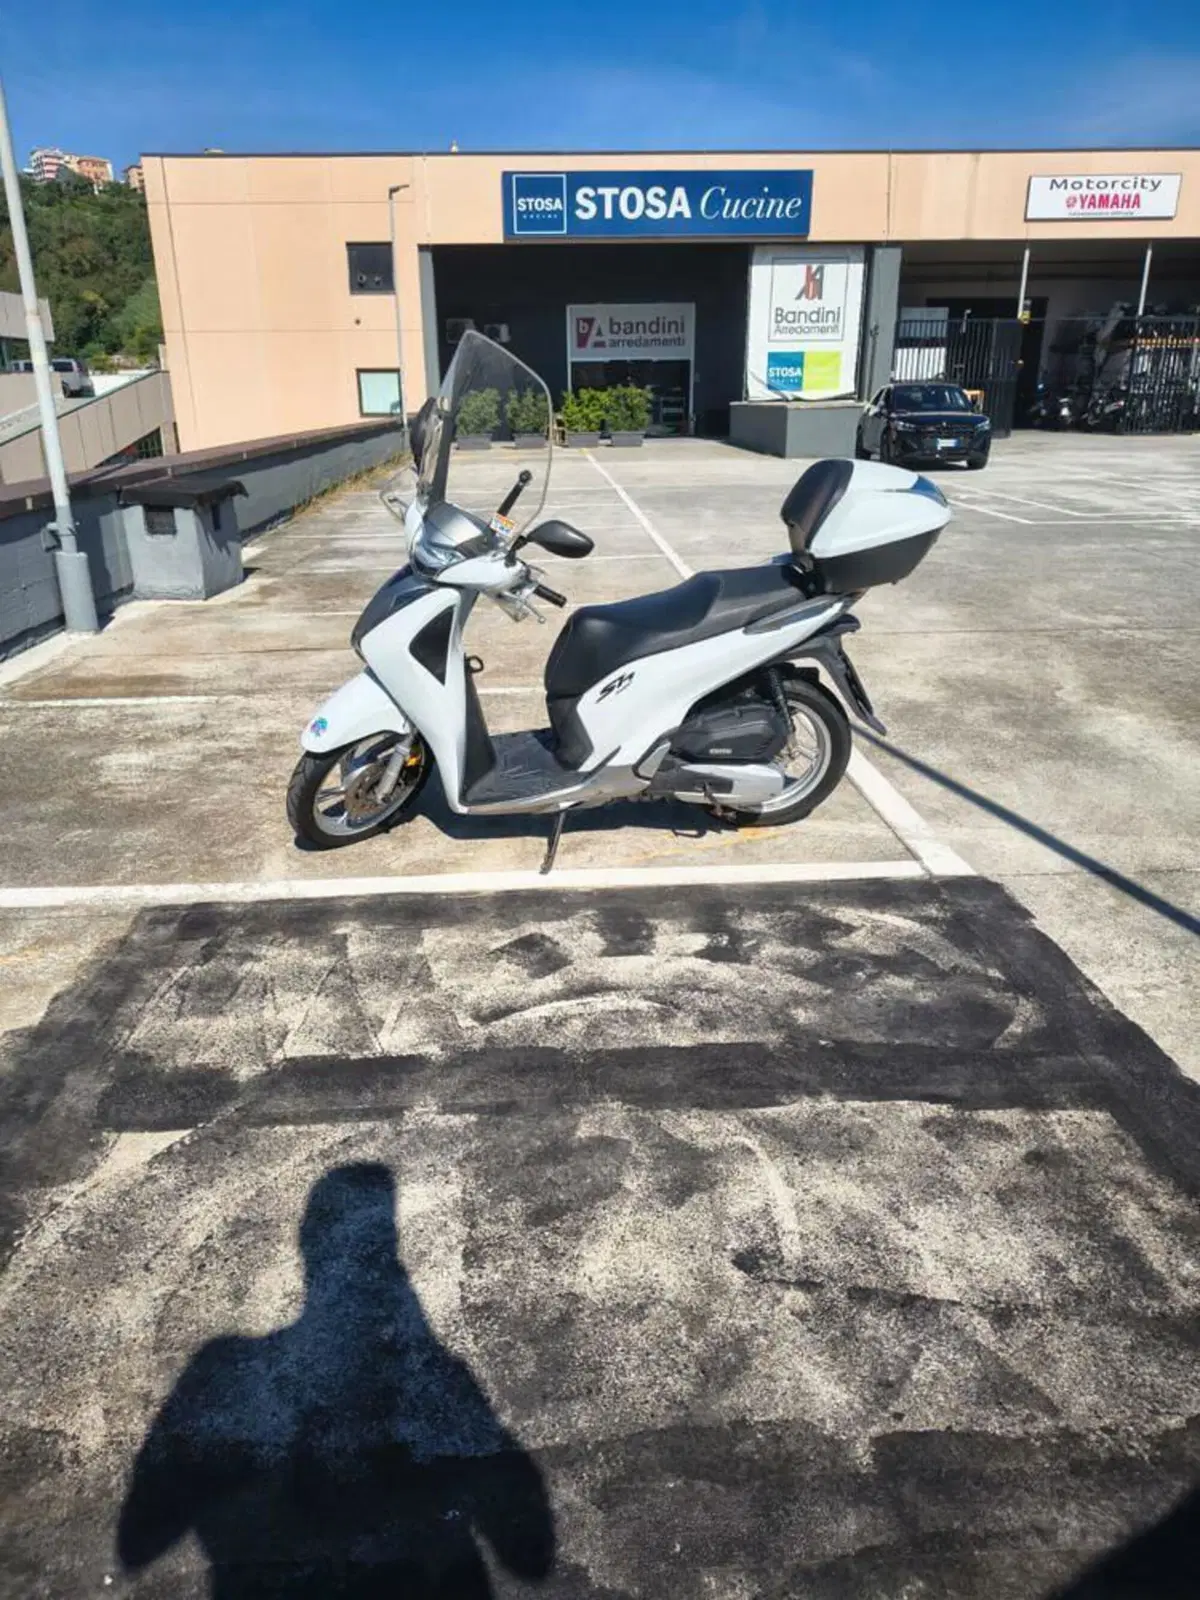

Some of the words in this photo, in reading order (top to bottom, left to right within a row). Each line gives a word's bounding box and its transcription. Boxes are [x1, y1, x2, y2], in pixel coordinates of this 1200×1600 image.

[1049, 177, 1162, 192] Motorcity
[517, 197, 563, 212] STOSA
[574, 186, 692, 220] STOSA
[700, 186, 802, 220] Cucine
[1079, 193, 1142, 209] YAMAHA
[774, 306, 841, 324] Bandini
[608, 315, 685, 335] bandini
[608, 336, 686, 348] arredamenti
[768, 367, 803, 378] STOSA
